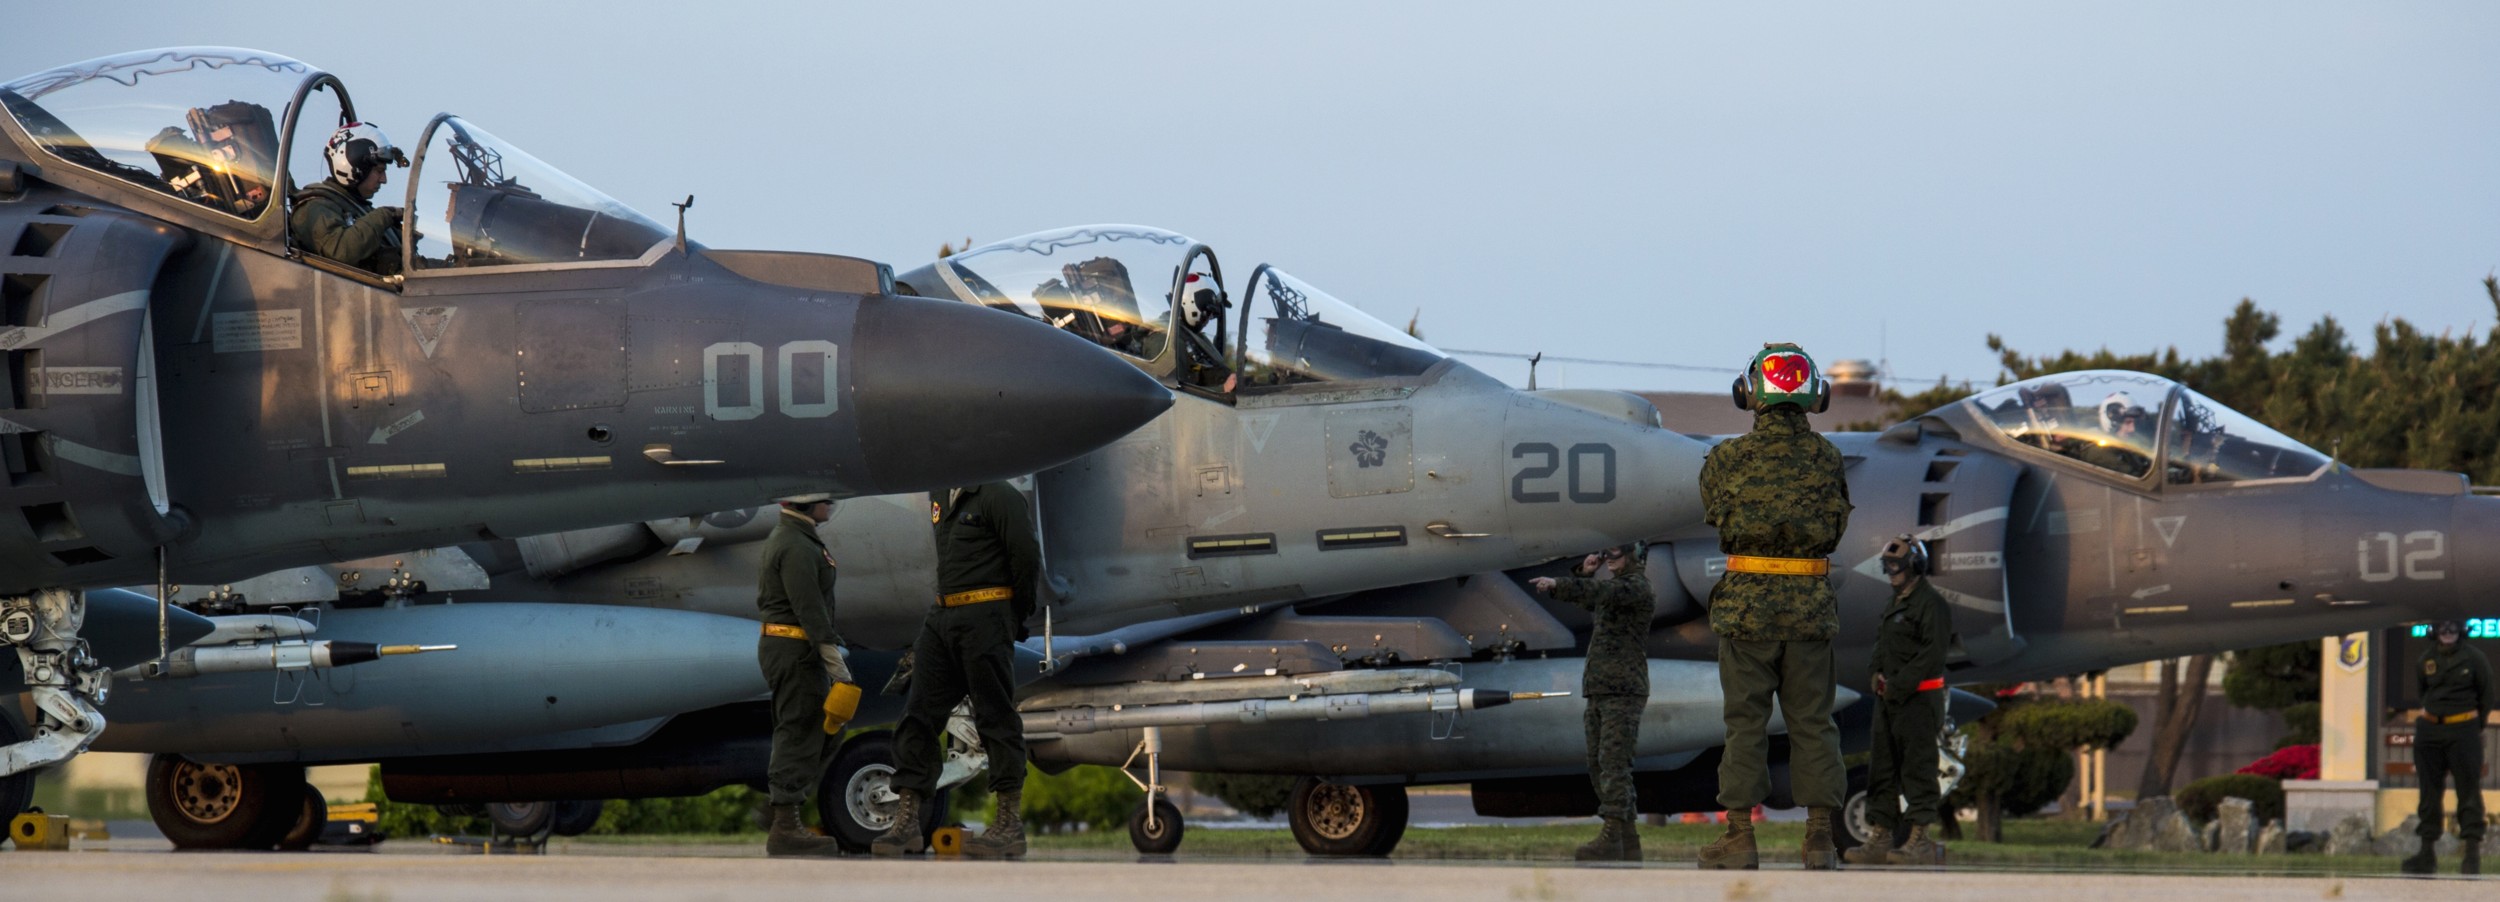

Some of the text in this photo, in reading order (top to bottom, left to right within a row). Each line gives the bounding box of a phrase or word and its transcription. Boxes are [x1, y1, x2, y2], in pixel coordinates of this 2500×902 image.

[704, 340, 839, 421] 00
[1763, 359, 1775, 371] W
[1796, 369, 1805, 382] L
[1511, 442, 1616, 503] 20
[2358, 530, 2445, 582] 02
